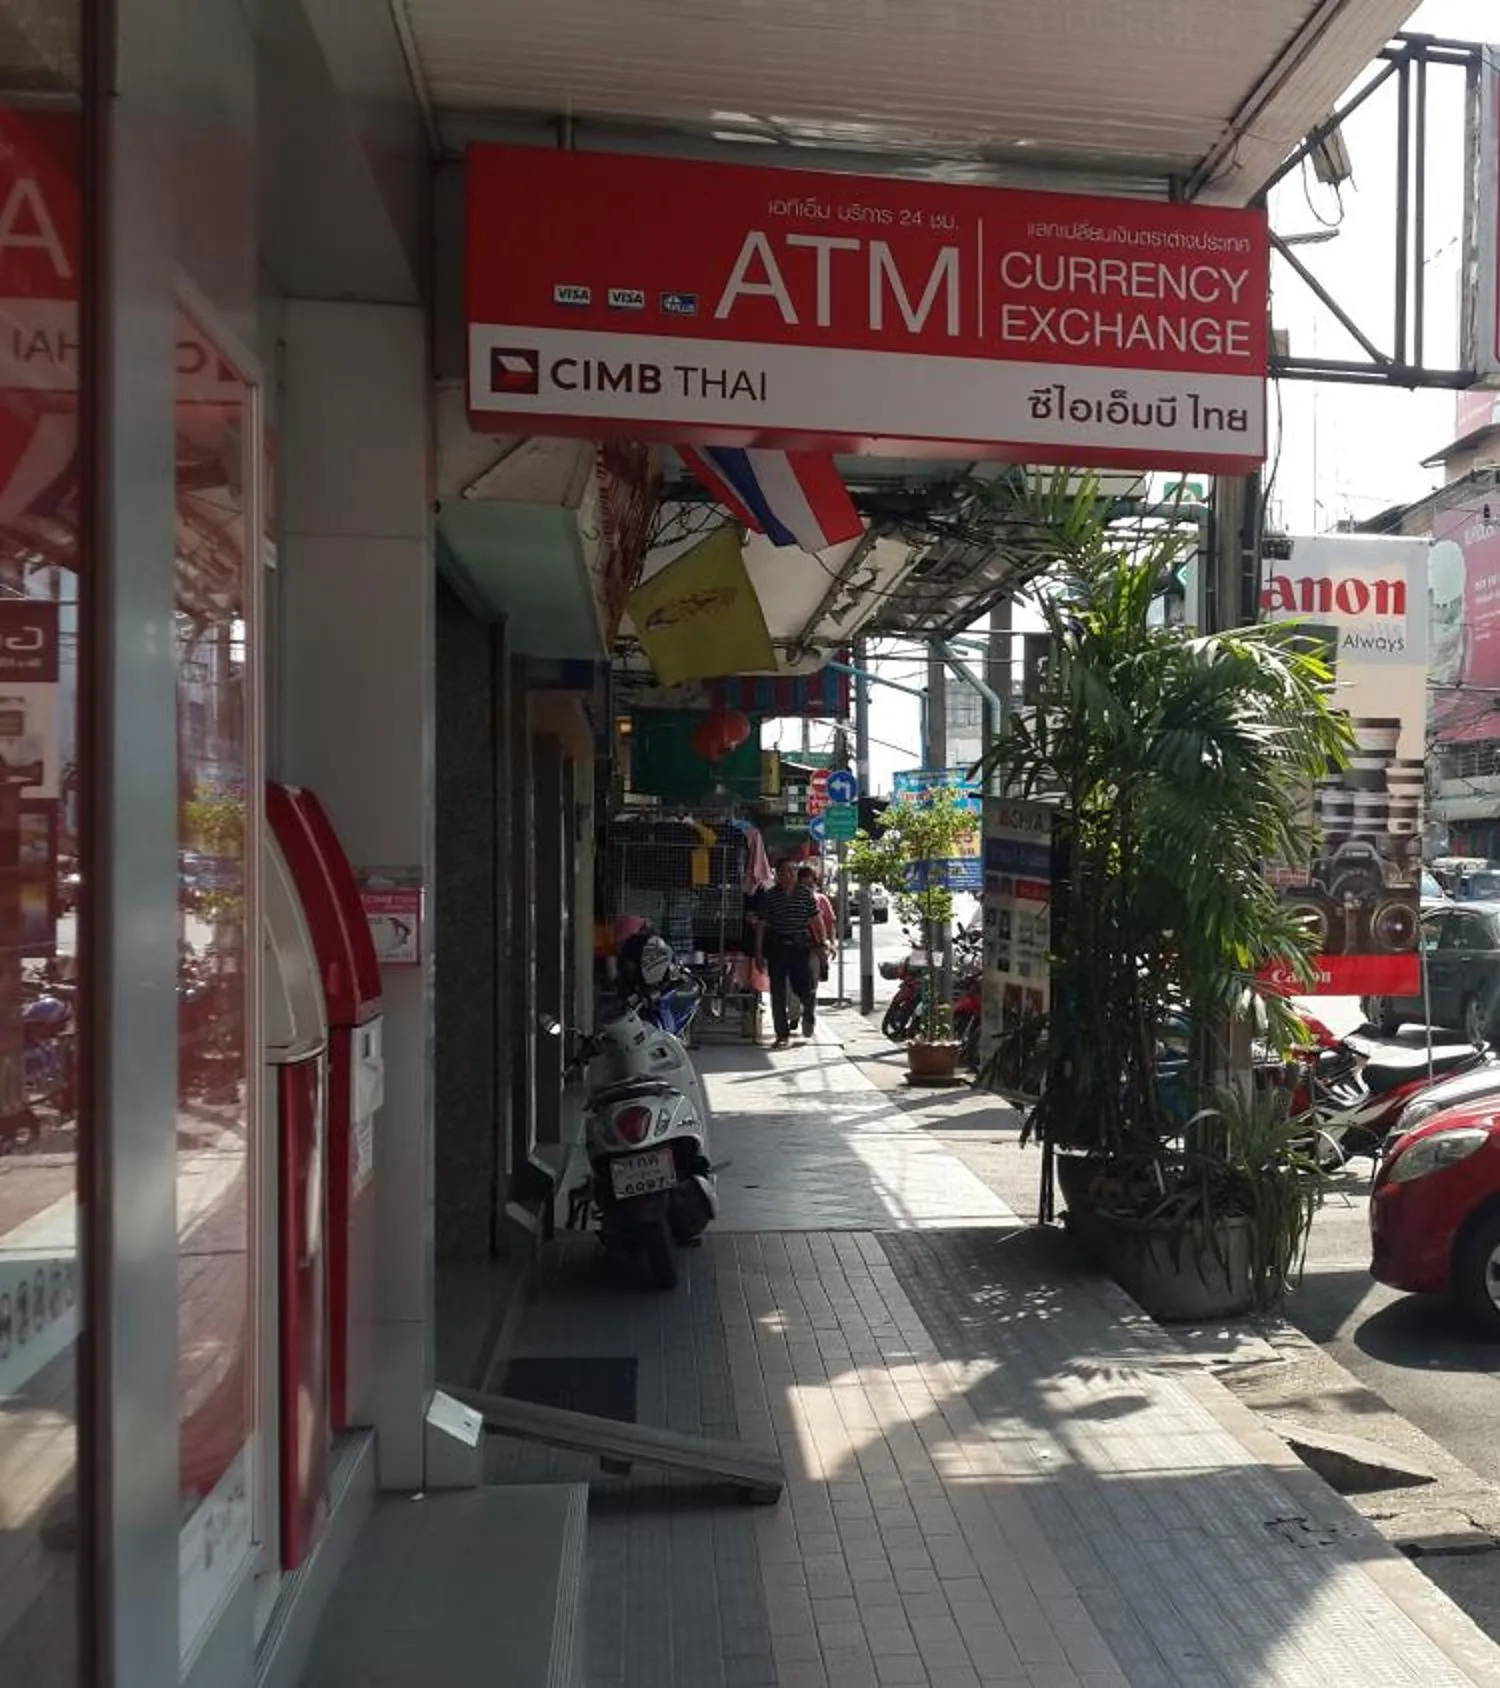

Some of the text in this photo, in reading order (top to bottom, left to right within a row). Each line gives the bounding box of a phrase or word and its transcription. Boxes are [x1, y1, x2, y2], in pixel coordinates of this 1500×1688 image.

[899, 209, 922, 225] 24
[558, 287, 588, 300] VISA
[612, 291, 643, 304] VISA
[714, 229, 960, 337] ATM
[1001, 251, 1249, 304] CURRENCY
[1002, 304, 1250, 357] EXCHANGE
[550, 356, 768, 403] CIMB THAI
[1027, 384, 1248, 432] ซีไอเอ็มบี ไทย
[1261, 574, 1407, 615] anon
[1342, 633, 1405, 653] Always
